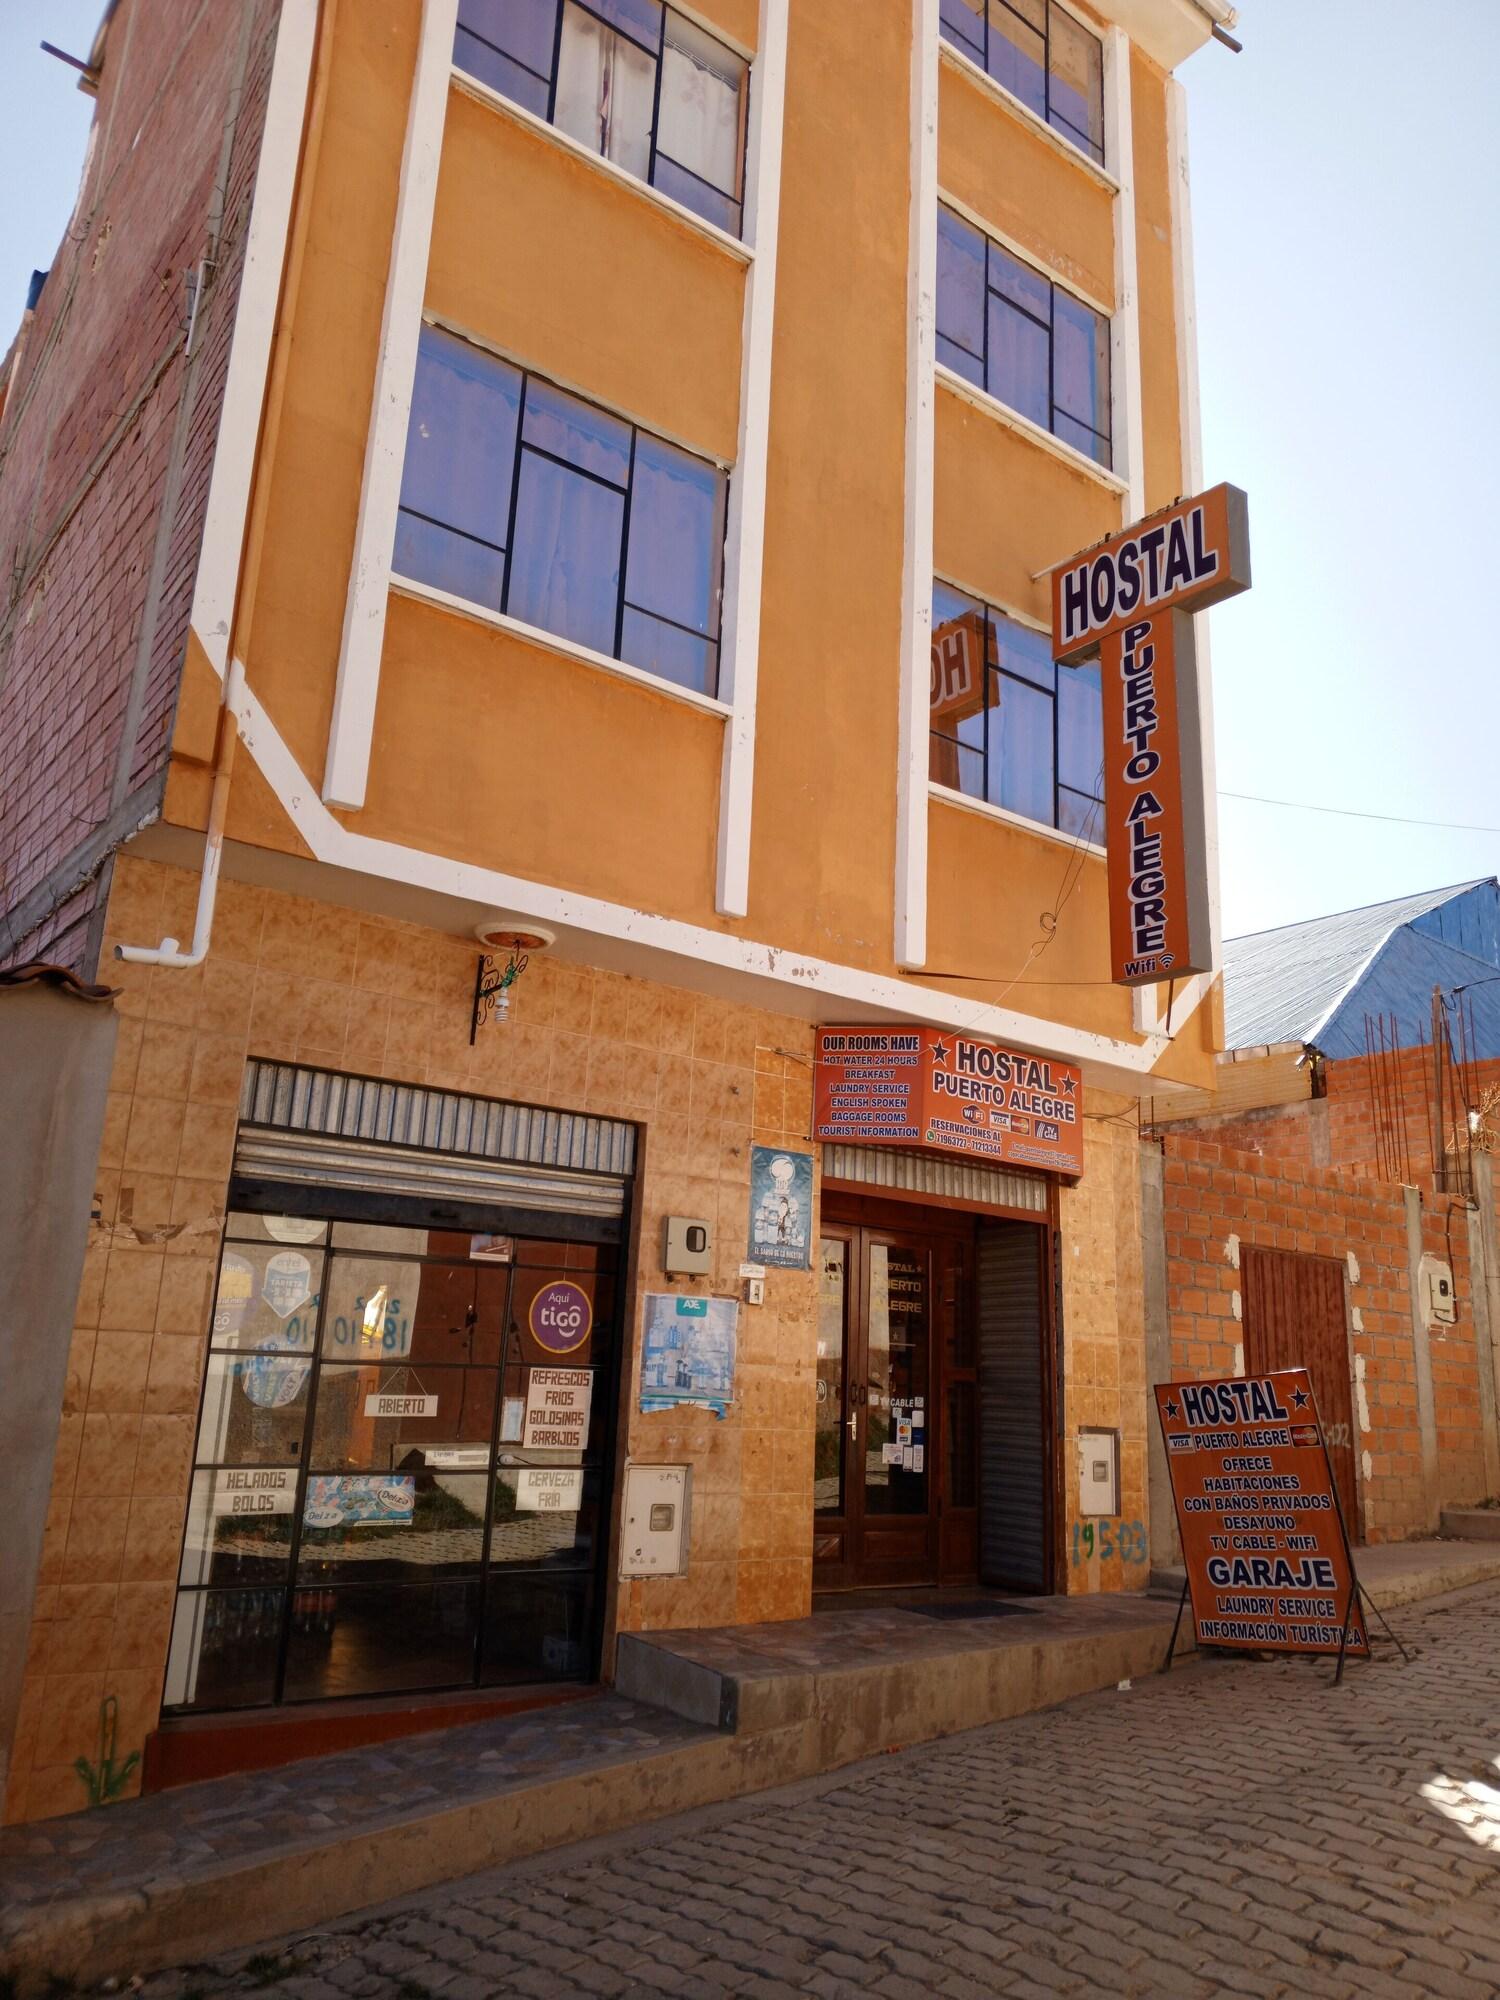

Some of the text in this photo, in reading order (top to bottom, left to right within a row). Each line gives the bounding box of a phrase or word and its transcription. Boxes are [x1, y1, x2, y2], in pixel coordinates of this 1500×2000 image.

[1061, 505, 1220, 645] HOSTAL
[1121, 621, 1168, 959] PUERTO ALEGRE
[1124, 957, 1156, 977] Wifi
[823, 1035, 920, 1051] OUR ROOMS HAVE
[823, 1055, 918, 1065] HOT WATER 24 HOURS
[956, 1040, 1058, 1095] HOSTAL
[845, 1070, 895, 1079] BREAKFAST
[830, 1084, 910, 1094] LAUNDRY SERVICE
[933, 1070, 1076, 1123] PUERTO ALEGRE
[831, 1098, 907, 1108] ENGLISH SPOKEN
[831, 1112, 906, 1122] BAGGAGE ROOMS
[994, 1116, 1007, 1125] VISA
[819, 1126, 919, 1137] TOURIST INFORMATION
[930, 1117, 992, 1140] RESERVACIONES
[531, 1370, 590, 1387] REFRESCOS
[378, 1398, 426, 1414] ABIERTO
[890, 1398, 914, 1408] CABLE
[1179, 1379, 1289, 1428] HOSTAL
[529, 1410, 584, 1427] GOLOSINAS
[531, 1431, 580, 1446] BARBIJOS
[1172, 1439, 1190, 1448] VISA
[1195, 1429, 1289, 1450] PUERTO ALEGRE
[1222, 1456, 1272, 1472] OFRECE
[226, 1471, 287, 1490] HELADOS
[527, 1471, 575, 1487] CERVEZA
[1203, 1475, 1300, 1492] HABITACIONES
[232, 1494, 274, 1513] BOLOS
[1184, 1494, 1331, 1512] CON BAÑOS PRIVADOS
[1223, 1515, 1296, 1530] DESAYUNO
[1210, 1535, 1229, 1550] TV
[1232, 1535, 1277, 1550] CABLE
[1285, 1535, 1318, 1550] WIFI
[1207, 1556, 1337, 1590] GARAJE
[1216, 1595, 1336, 1618] LAUNDRY SERVICE
[1200, 1619, 1288, 1642] INFORMACIÓN
